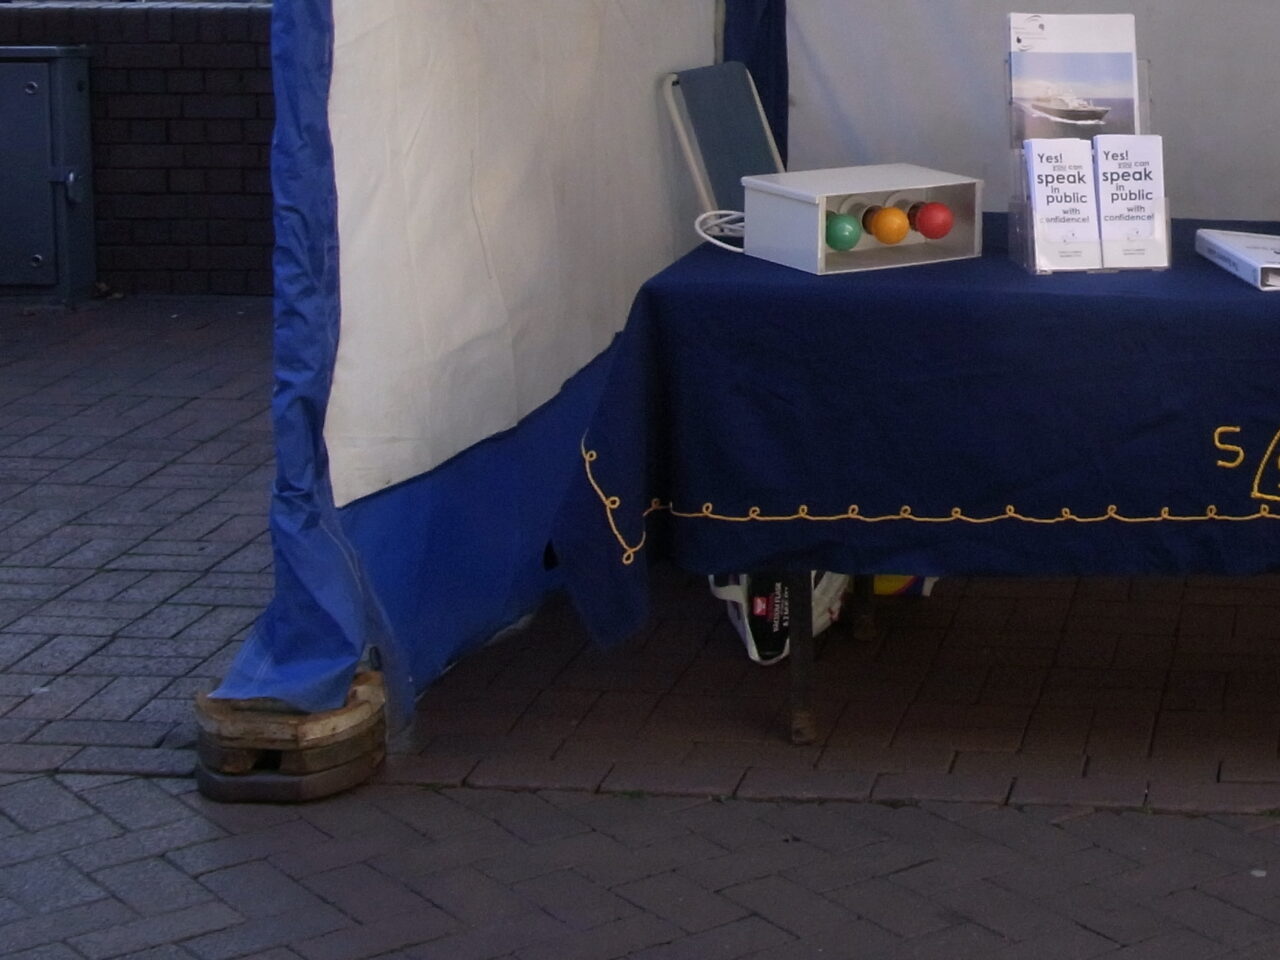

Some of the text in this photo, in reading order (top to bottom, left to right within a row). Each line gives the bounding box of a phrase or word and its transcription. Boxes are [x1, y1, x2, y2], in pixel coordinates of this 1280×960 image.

[1037, 153, 1063, 164] Yes!
[1103, 150, 1129, 161] Yes!
[1134, 160, 1150, 168] can
[1036, 171, 1087, 187] speak
[1102, 167, 1153, 185] speak
[1050, 185, 1060, 194] in
[1115, 182, 1125, 191] in
[1046, 192, 1088, 206] public
[1110, 189, 1153, 204] public
[1062, 207, 1081, 216] with
[1126, 204, 1146, 213] with
[1040, 215, 1090, 224] confidence!
[1103, 212, 1155, 222] confidence!
